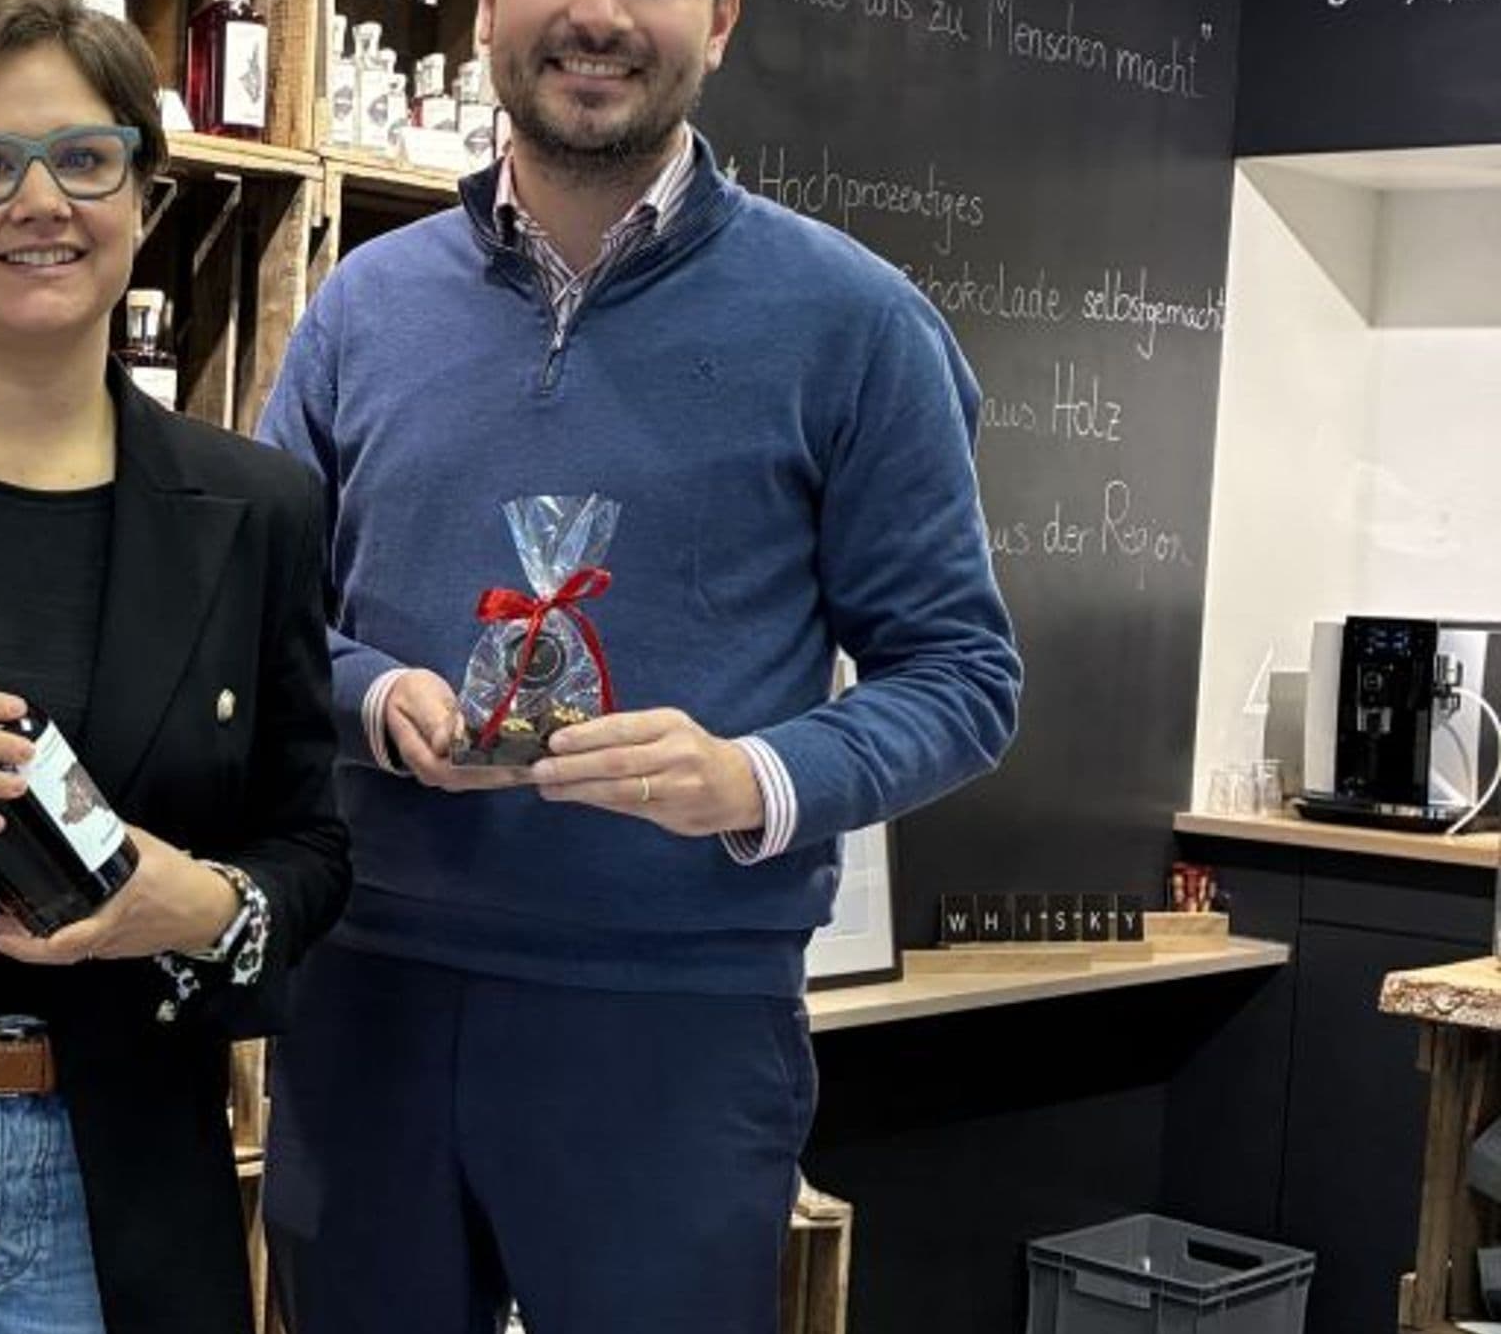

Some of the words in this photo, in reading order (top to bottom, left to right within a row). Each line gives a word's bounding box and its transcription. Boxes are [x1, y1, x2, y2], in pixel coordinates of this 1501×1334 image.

[983, 397, 1037, 430] aus
[1052, 361, 1122, 442] Holz
[989, 521, 1031, 556] us
[1043, 501, 1095, 556] der
[1102, 480, 1194, 591] Region
